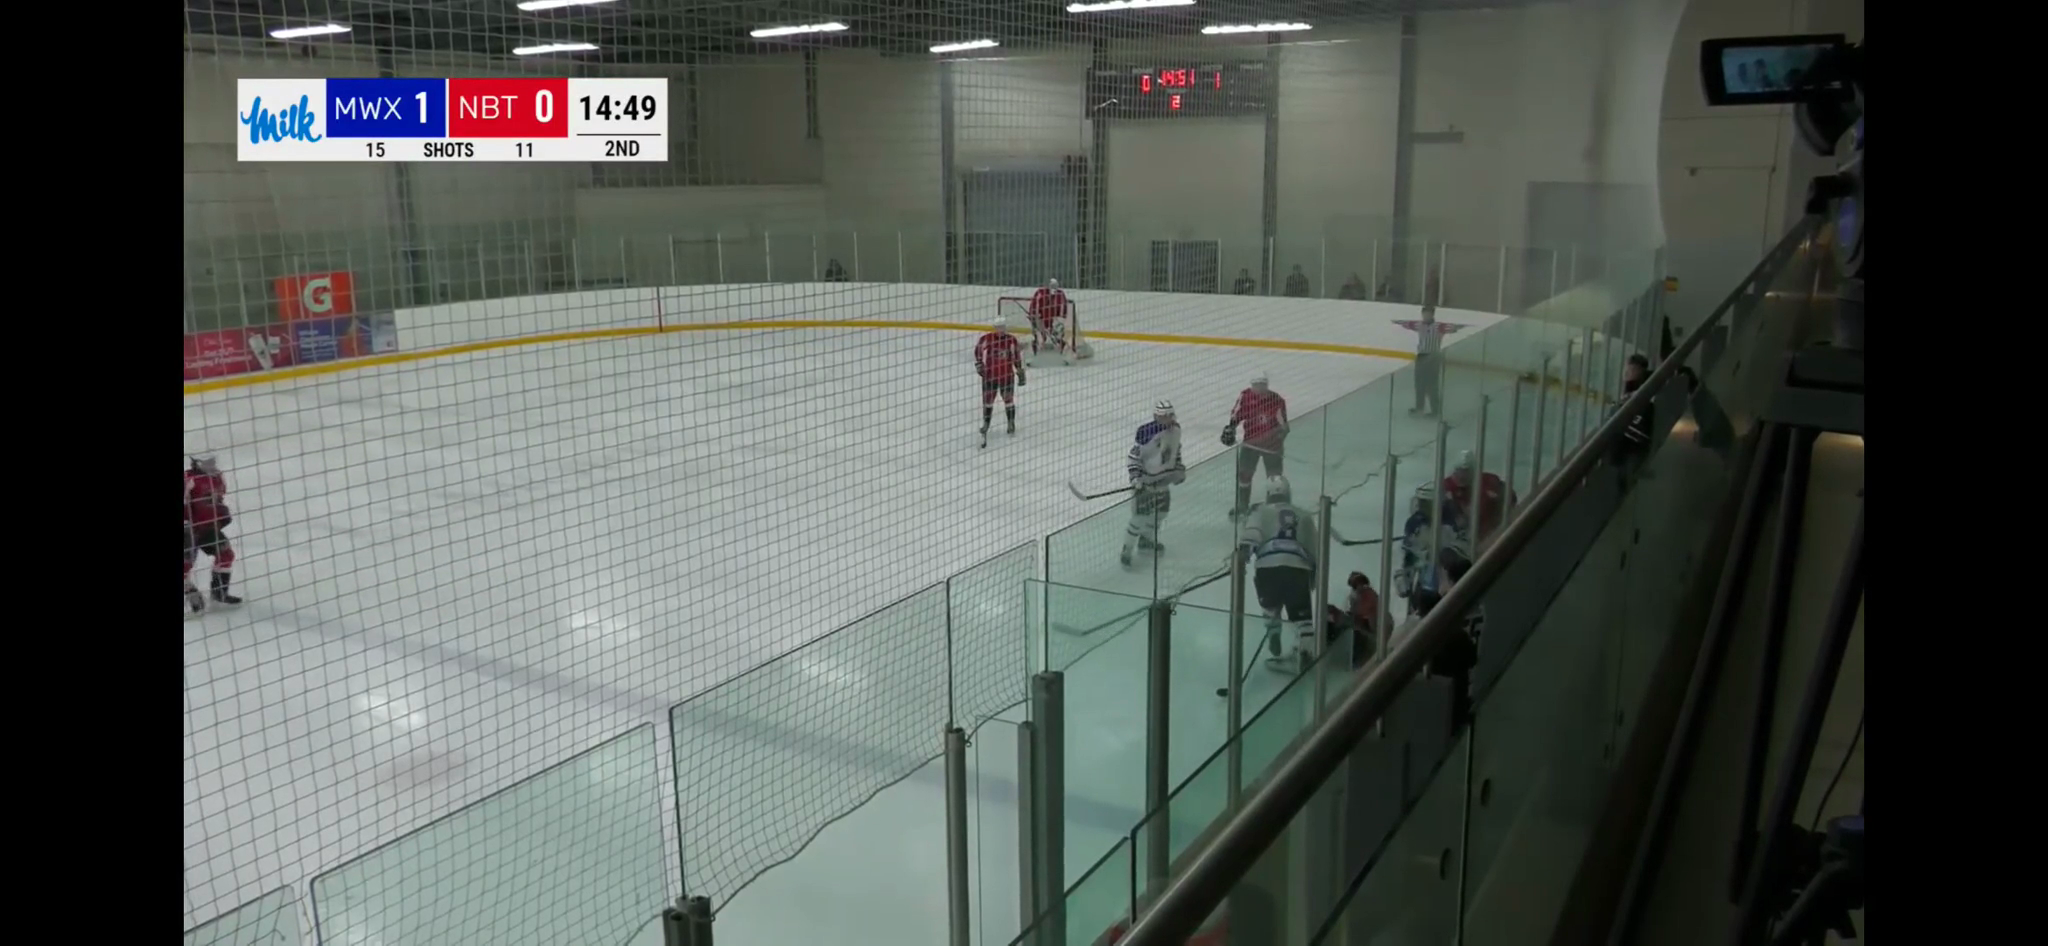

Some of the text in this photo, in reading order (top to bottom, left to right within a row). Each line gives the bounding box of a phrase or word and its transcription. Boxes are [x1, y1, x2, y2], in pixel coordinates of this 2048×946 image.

[1142, 75, 1150, 91] 0
[1172, 94, 1181, 108] 2
[303, 277, 333, 313] G
